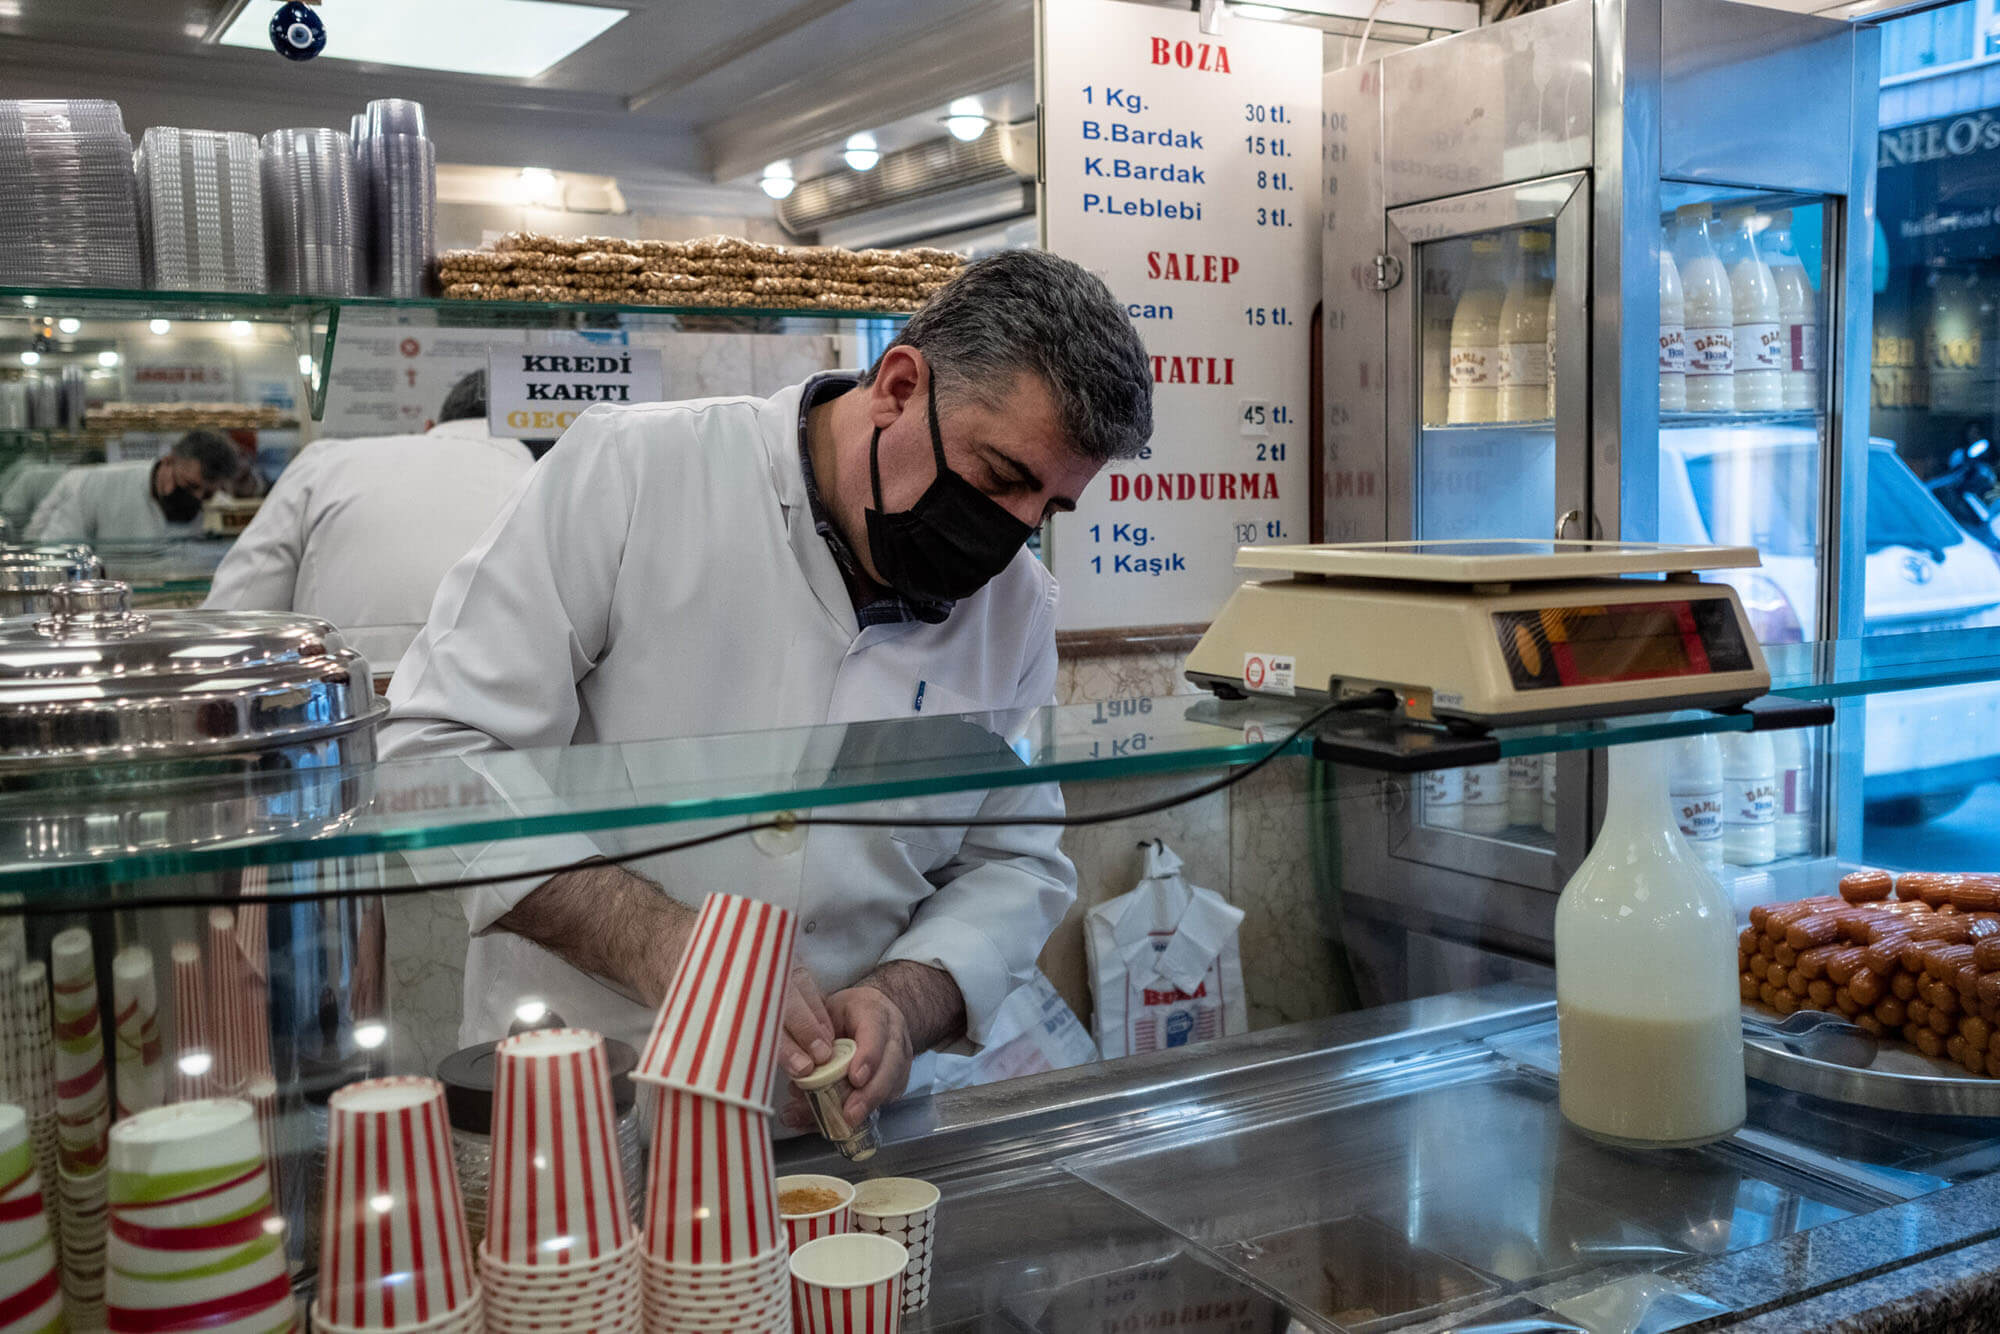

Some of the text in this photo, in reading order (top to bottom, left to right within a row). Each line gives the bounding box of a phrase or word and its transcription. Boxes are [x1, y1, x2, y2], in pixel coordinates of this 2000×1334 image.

[1151, 36, 1231, 74] BOZA
[1082, 86, 1291, 124] 1 Kg. 30 tl.
[1083, 121, 1291, 157] B.Bardak 15 tl.
[1085, 157, 1293, 191] K.Bardak 8 tl.
[1084, 194, 1292, 227] P.Leblebi 3 tl.
[1147, 251, 1239, 283] SALEP
[1246, 308, 1266, 325] 15
[1273, 308, 1292, 325] tl.
[522, 352, 632, 374] KREDİ
[1150, 355, 1234, 385] TATLI
[526, 383, 630, 401] KARTI
[1244, 406, 1293, 424] 45 tl.
[1257, 443, 1285, 461] 2 tl
[1109, 473, 1279, 501] DONDURMA
[1090, 521, 1287, 546] 1 Kg. 130 tl.
[1091, 553, 1186, 576] 1 Kaşık
